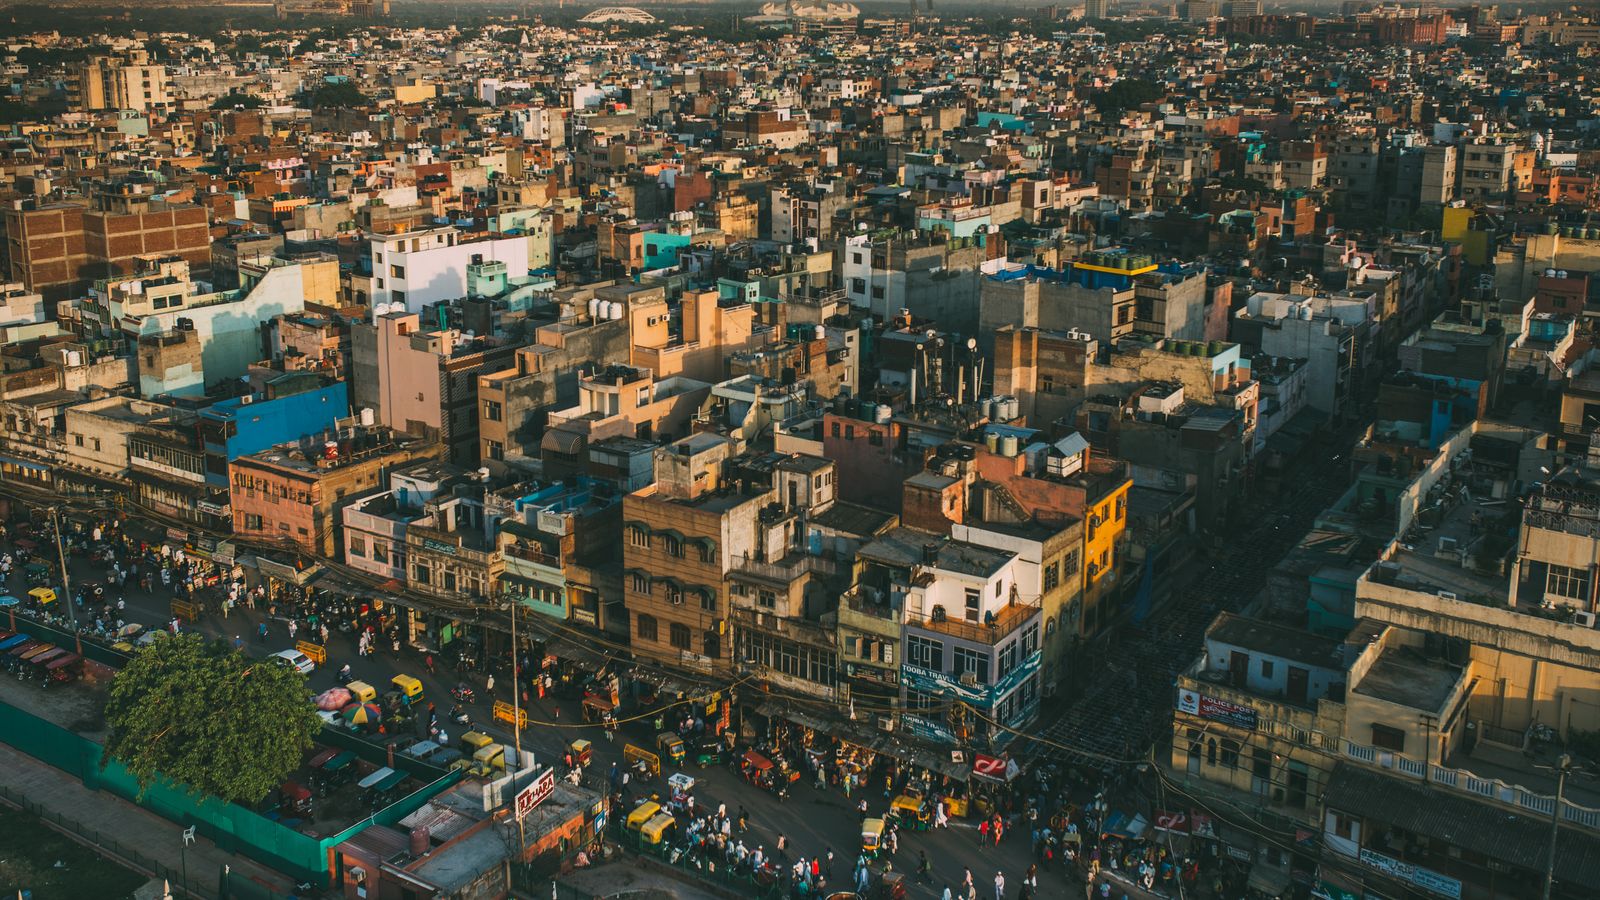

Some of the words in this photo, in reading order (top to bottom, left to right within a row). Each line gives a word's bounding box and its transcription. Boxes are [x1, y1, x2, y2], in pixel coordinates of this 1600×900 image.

[902, 664, 927, 676] TOOBA
[1202, 695, 1232, 708] POLICE
[1234, 704, 1256, 715] POST
